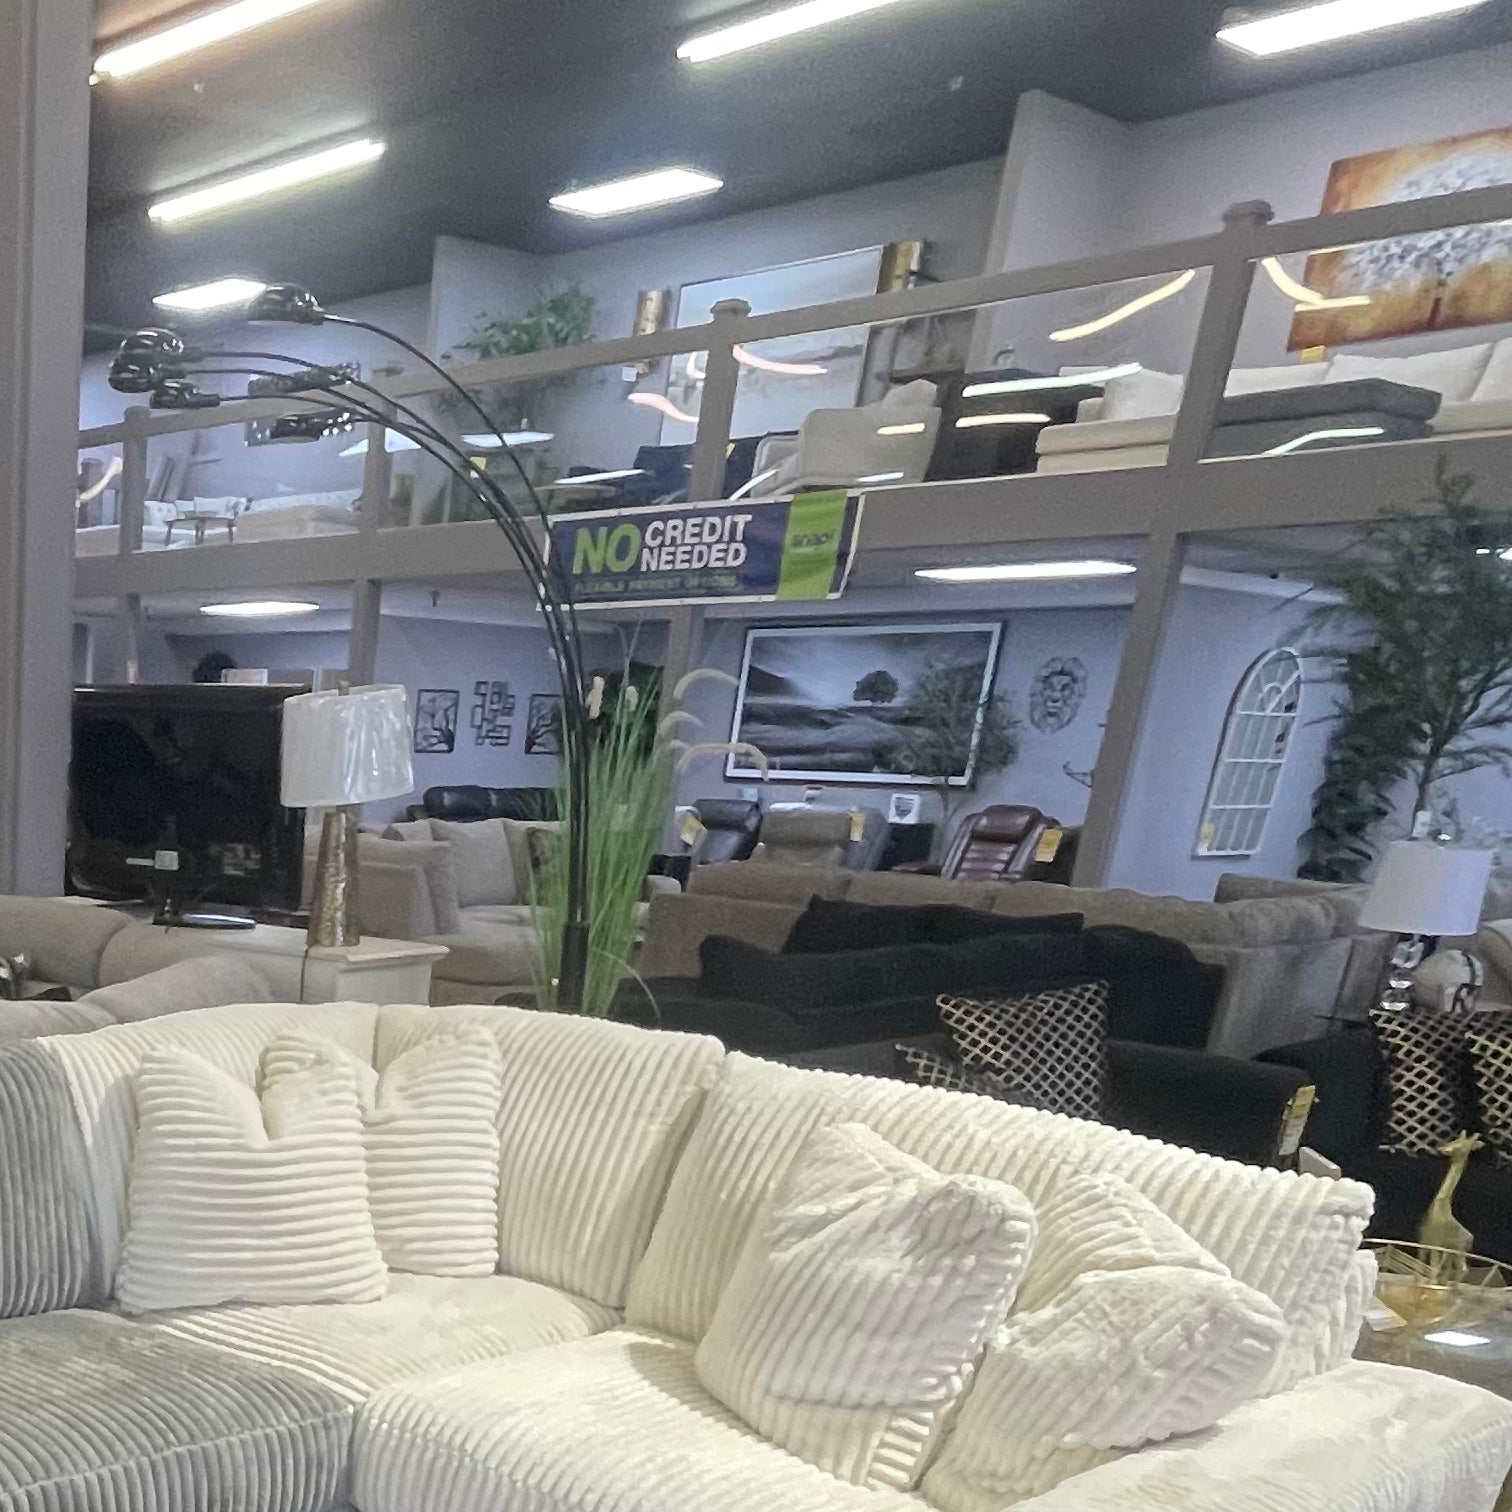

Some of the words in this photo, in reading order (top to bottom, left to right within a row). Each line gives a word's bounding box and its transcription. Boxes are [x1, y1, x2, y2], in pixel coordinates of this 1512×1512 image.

[573, 524, 641, 575] NO
[644, 514, 752, 547] CREDIT
[640, 543, 747, 572] NEEDED
